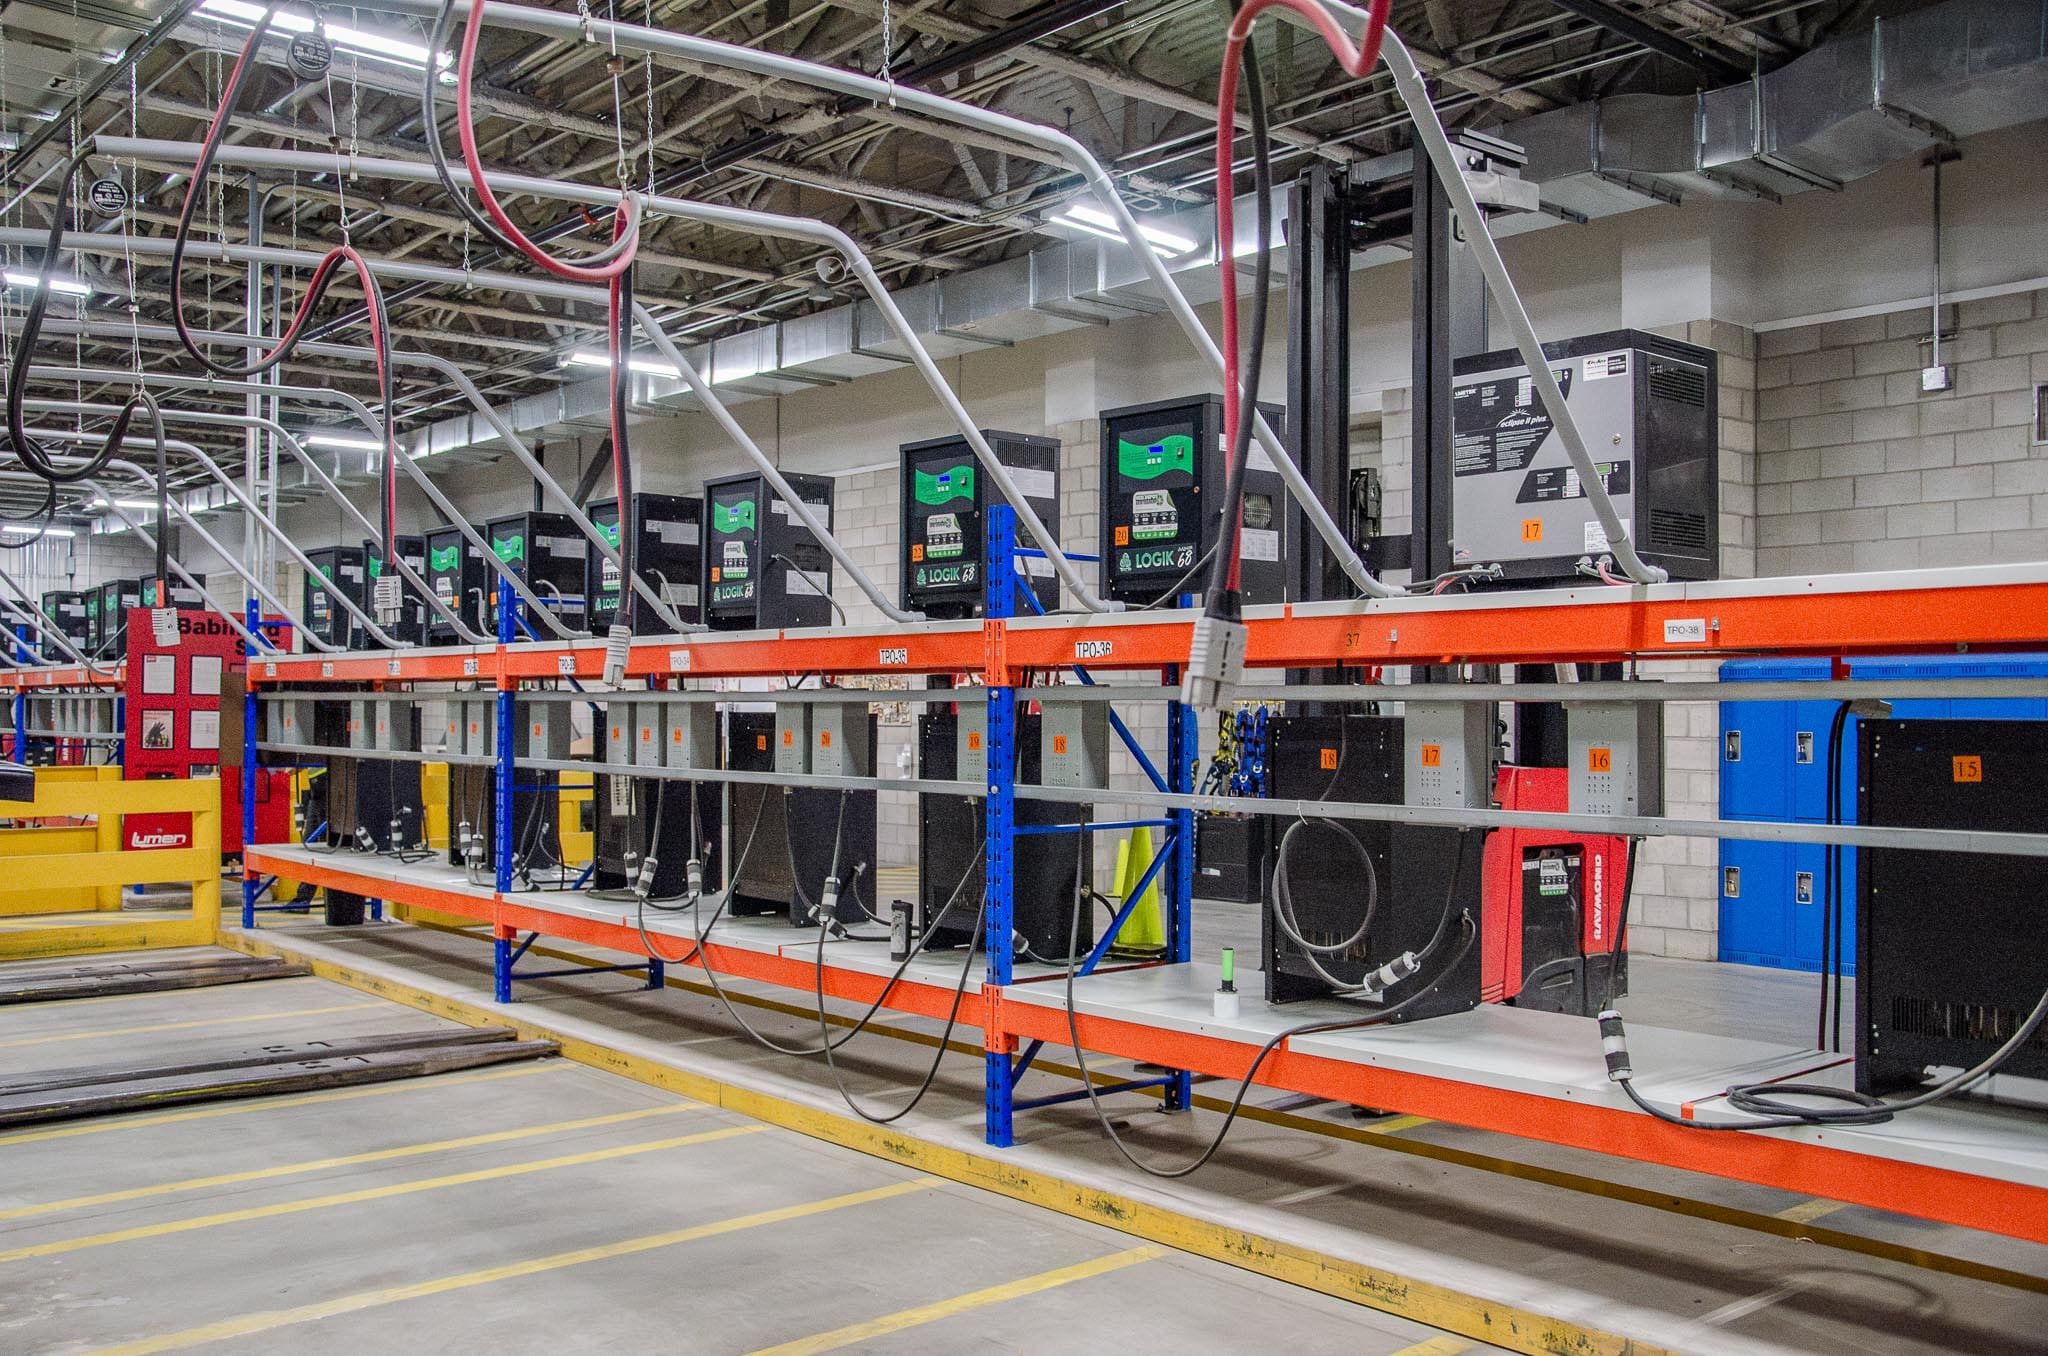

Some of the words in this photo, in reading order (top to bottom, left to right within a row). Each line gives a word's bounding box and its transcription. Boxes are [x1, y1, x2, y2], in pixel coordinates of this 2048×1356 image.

[1500, 417, 1525, 428] eclipse
[1531, 415, 1547, 426] plus
[1116, 530, 1127, 542] 20
[1526, 524, 1540, 539] 17
[1135, 550, 1175, 569] LOGIK
[1177, 549, 1193, 568] 68
[929, 566, 960, 583] LOGIK
[962, 567, 976, 583] 68
[722, 585, 744, 600] LOGIK
[602, 597, 620, 610] LOGI
[1667, 625, 1699, 635] TPO-38
[1345, 633, 1360, 647] 37
[880, 649, 907, 665] TPO-35
[1076, 641, 1112, 658] TPO-36
[969, 735, 980, 749] 19
[1055, 738, 1066, 752] 18
[1322, 753, 1336, 767] 18
[1424, 749, 1440, 764] 17
[1592, 753, 1609, 768] 16
[1958, 761, 1978, 777] 15
[131, 832, 187, 848] lumen
[1593, 854, 1603, 940] RAYMOND
